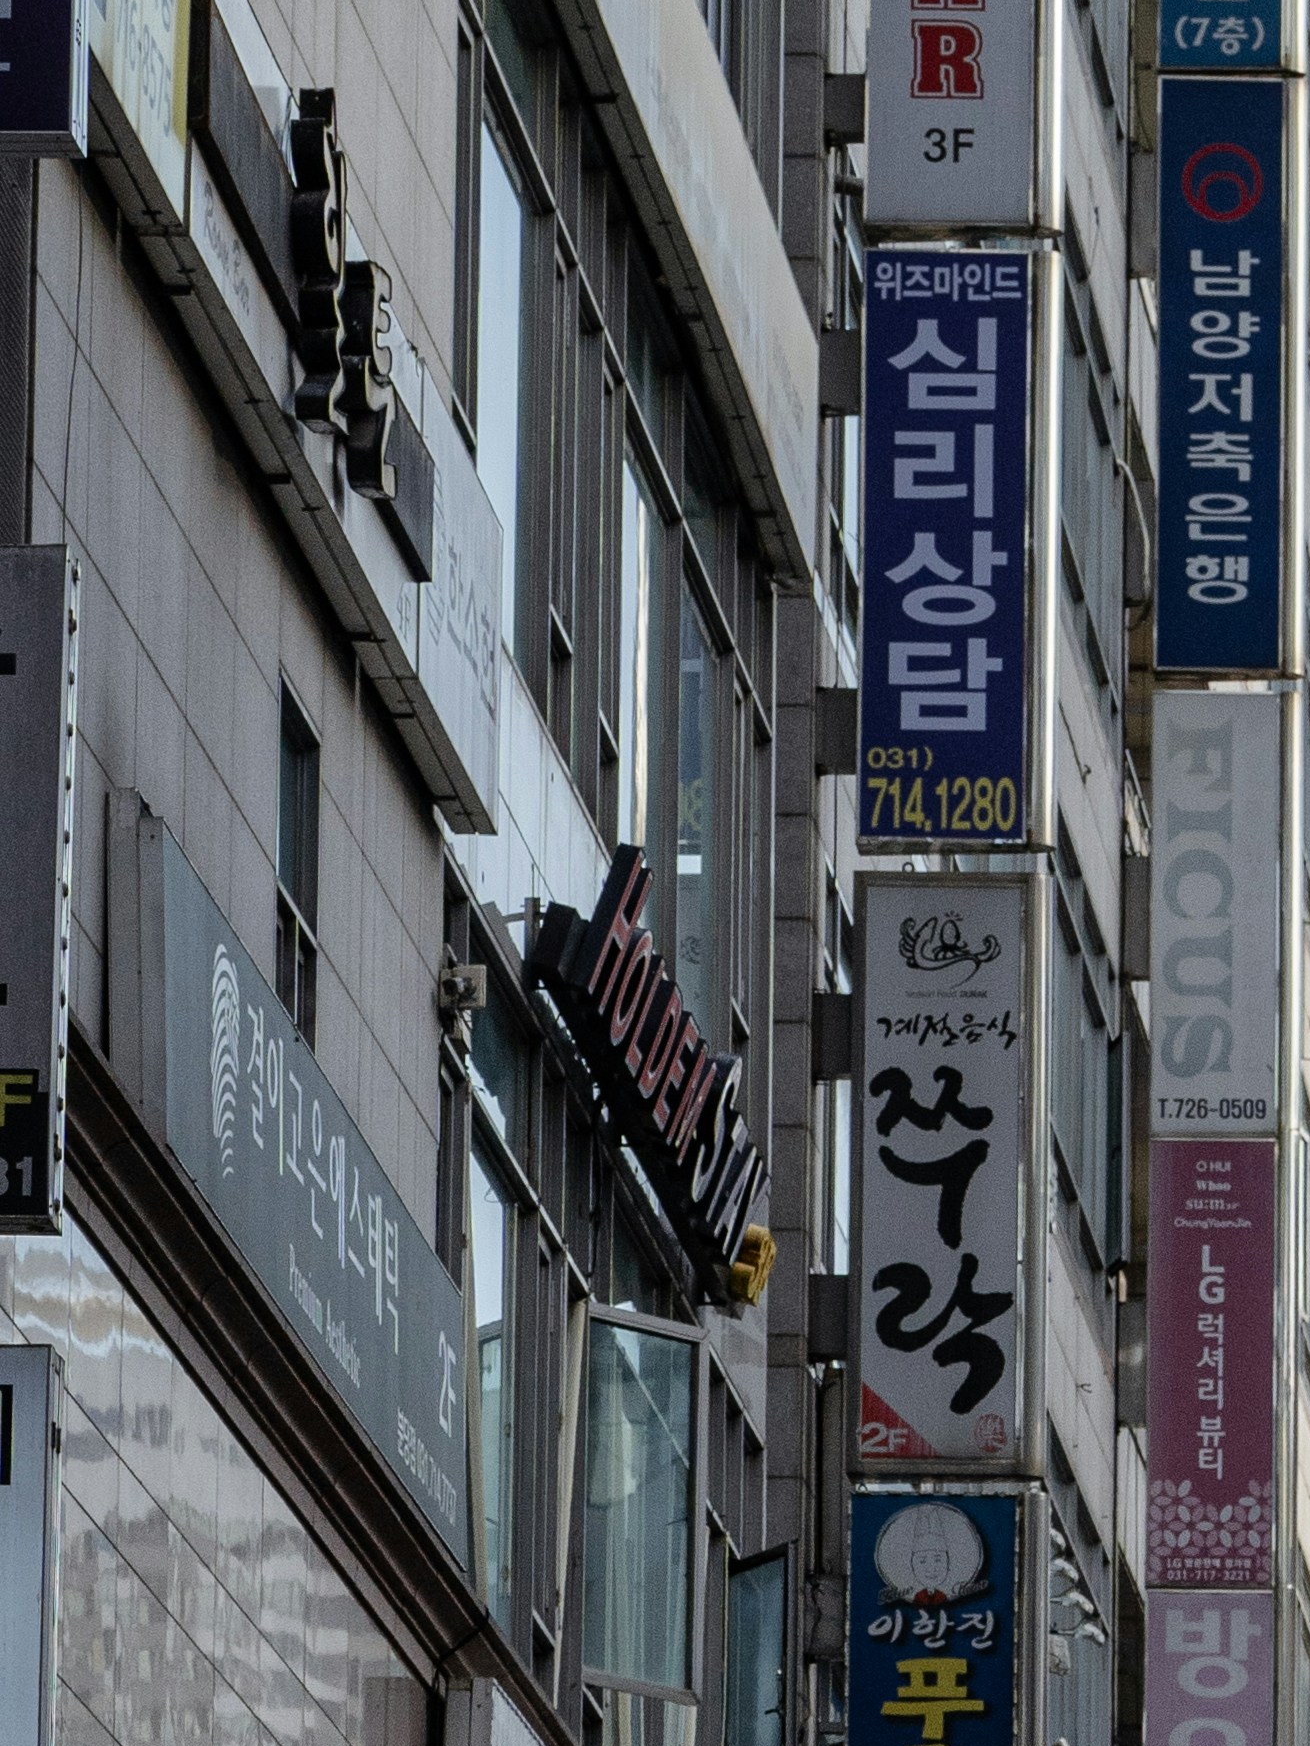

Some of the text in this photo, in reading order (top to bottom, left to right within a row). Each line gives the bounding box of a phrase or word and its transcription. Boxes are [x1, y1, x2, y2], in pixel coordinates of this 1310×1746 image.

[1174, 15, 1266, 56] (7층)
[923, 128, 975, 163] 3F
[874, 262, 1023, 303] 위즈마인드
[1183, 249, 1262, 605] 남양저축은행
[884, 316, 1007, 732] 심리상담
[867, 747, 1017, 835] 031) 714.1280
[1157, 1098, 1267, 1121] T.726-0509
[1198, 1244, 1226, 1305] LG
[860, 1421, 908, 1453] 2F
[1196, 1417, 1227, 1480] 뷰티
[868, 1609, 995, 1649] 이한진
